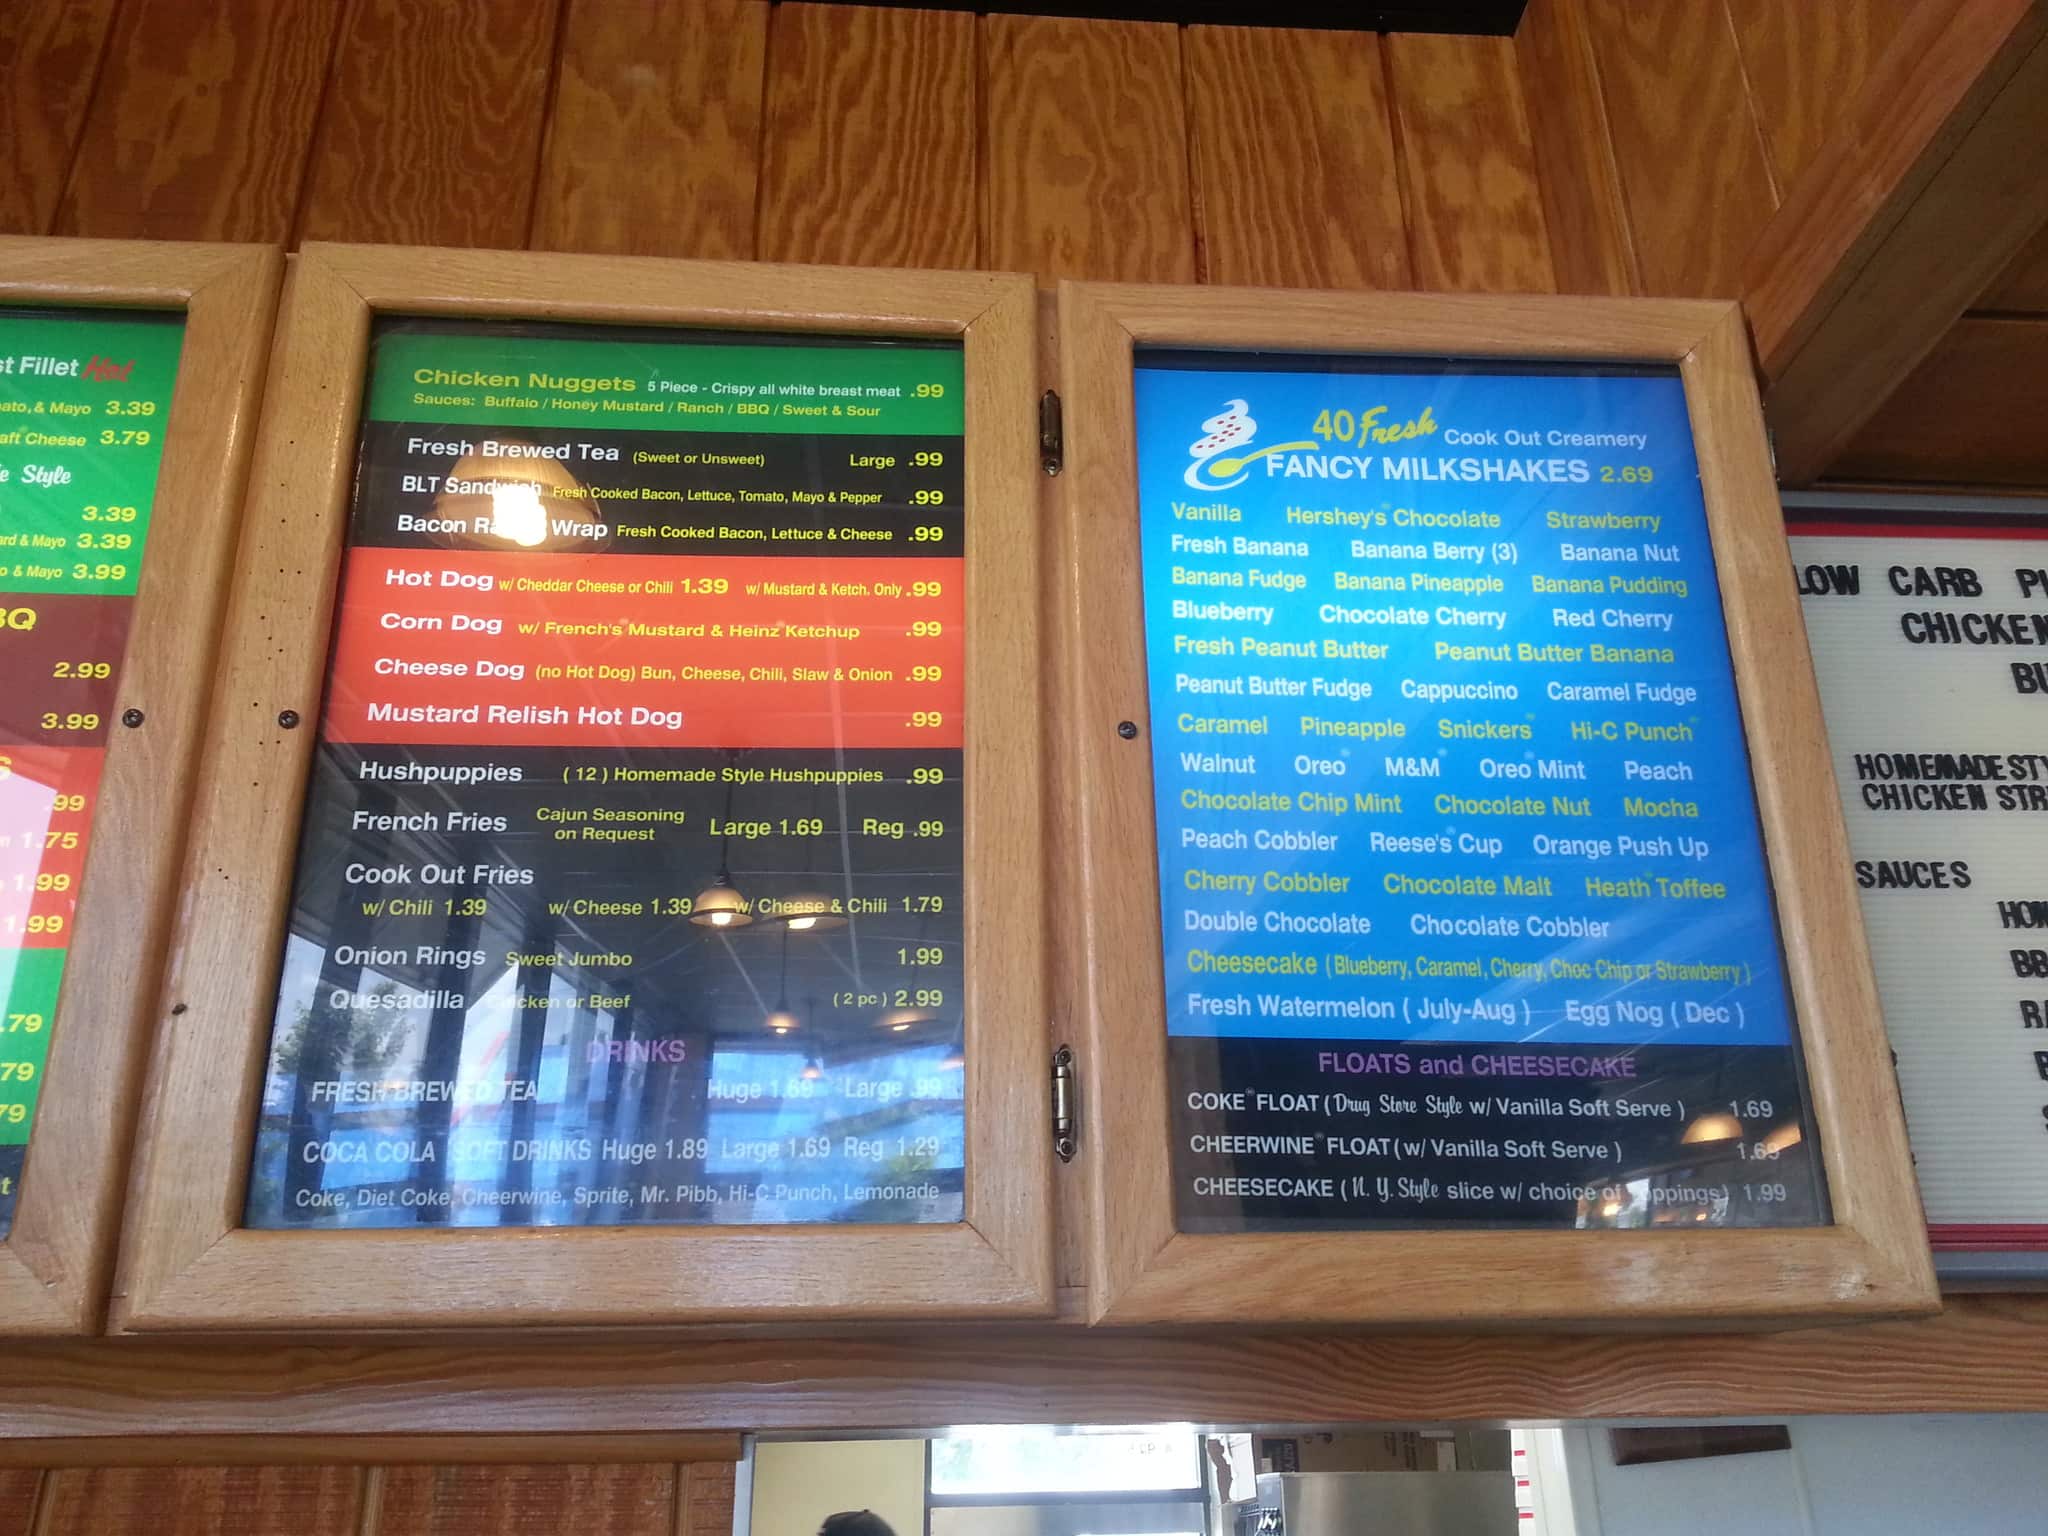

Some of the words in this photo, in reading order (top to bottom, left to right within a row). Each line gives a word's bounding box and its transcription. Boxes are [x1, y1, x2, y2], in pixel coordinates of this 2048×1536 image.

[19, 356, 79, 377] Fillet
[81, 355, 136, 382] Hot
[414, 368, 520, 387] Chicken
[528, 373, 637, 393] Nuggets
[660, 382, 698, 393] Piece
[711, 382, 756, 397] Crispy
[779, 384, 815, 396] white
[819, 385, 862, 397] breast
[910, 384, 944, 398] .99
[50, 402, 92, 417] Mayo
[105, 401, 156, 416] 3.39
[414, 393, 476, 407] Sauces:
[485, 396, 539, 409] Buffalo
[551, 398, 598, 412] Honey
[603, 400, 664, 413] Mustard
[677, 402, 724, 415] Ranch
[737, 403, 770, 416] BBQ
[847, 405, 881, 417] Sour
[25, 432, 87, 446] Cheese
[100, 430, 151, 446] 3.79
[1313, 409, 1355, 443] 40
[1358, 405, 1438, 449] Fresh
[1444, 429, 1498, 446] Cook
[1504, 430, 1541, 446] Out
[1546, 430, 1647, 450] Creamery
[407, 438, 474, 457] Fresh
[482, 440, 570, 460] Brewed
[577, 443, 620, 461] Tea
[849, 453, 896, 470] Large
[21, 464, 72, 488] Style
[1265, 453, 1372, 480] FANCY
[1383, 456, 1590, 483] MILKSHAKES
[1600, 466, 1654, 484] 2.69
[401, 475, 440, 492] BLT
[591, 487, 638, 500] Cooked
[792, 491, 825, 505] Mayo
[840, 492, 882, 505] Pepper
[1171, 501, 1242, 523] Vanilla
[1286, 506, 1387, 530] Hershey's
[1393, 509, 1501, 529] Chocolate
[1546, 511, 1662, 533] Strawberry
[32, 534, 67, 550] Mayo
[77, 533, 132, 549] 3.39
[551, 519, 608, 540] Wrap
[660, 526, 715, 540] Cooked
[840, 528, 893, 541] Cheese
[1171, 534, 1227, 554] Fresh
[1233, 536, 1309, 557] Banana
[1433, 541, 1485, 564] Berry
[1643, 544, 1681, 563] Nut
[27, 565, 63, 580] Mayo
[72, 563, 126, 580] 3.99
[385, 569, 432, 587] Hot
[440, 570, 493, 592] Dog
[517, 579, 571, 592] Cheddar
[576, 580, 625, 593] Cheese
[681, 578, 728, 594] 1.39
[1249, 569, 1307, 593] Fudge
[1411, 573, 1504, 595] Pineapple
[1610, 575, 1688, 597] Pudding
[1888, 565, 1983, 597] CARB
[380, 612, 442, 630] Corn
[451, 614, 503, 635] Dog
[544, 622, 623, 636] French's
[729, 625, 780, 638] Heinz
[785, 625, 860, 640] Ketchup
[1172, 599, 1274, 626] Blueberry
[1553, 608, 1595, 628] Red
[1602, 609, 1673, 632] Cherry
[1434, 641, 1511, 661] Peanut
[1517, 643, 1584, 662] Butter
[1590, 644, 1675, 664] Banana
[53, 661, 111, 680] 2.99
[374, 657, 468, 676] Cheese
[475, 660, 525, 681] Dog
[792, 667, 829, 681] Slaw
[849, 668, 893, 682] Onion
[1400, 679, 1519, 703] Cappuccino
[1546, 681, 1630, 702] Caramel
[1635, 683, 1697, 706] Fudge
[41, 712, 100, 730] 3.99
[367, 702, 479, 723] Mustard
[487, 705, 569, 725] Relish
[577, 707, 623, 726] Hot
[630, 707, 682, 730] Dog
[905, 711, 943, 728] .99
[1300, 716, 1406, 741] Pineapple
[1438, 719, 1533, 740] Snickers
[1624, 722, 1693, 742] Punch
[359, 761, 523, 785] Hushpuppies
[614, 767, 716, 782] Homemade
[721, 768, 765, 785] Style
[770, 768, 883, 785] Hushpuppies
[1181, 752, 1256, 774] Walnut
[1294, 755, 1346, 776] Oreo
[1385, 757, 1440, 777] M&M
[1624, 761, 1693, 781] Peach
[1853, 753, 2007, 781] HOMEMADE
[1354, 793, 1403, 814] Mint
[1624, 797, 1698, 818] Mocha
[1861, 783, 1988, 811] CHICKEN
[352, 811, 438, 832] French
[446, 812, 508, 832] Fries
[709, 818, 772, 840] Large
[779, 819, 823, 836] 1.69
[862, 818, 905, 839] Reg
[536, 807, 588, 823] Cajun
[592, 808, 685, 824] Seasoning
[582, 827, 655, 843] Request
[1254, 829, 1338, 851] Cobbler
[1370, 831, 1452, 853] Reese's
[1533, 834, 1611, 859] Orange
[1618, 835, 1672, 857] Push
[345, 863, 411, 884] Cook
[420, 864, 466, 885] Out
[473, 864, 535, 885] Fries
[1854, 860, 1972, 889] SAUCES
[1504, 875, 1552, 897] Malt
[1656, 877, 1726, 899] Toffee
[388, 899, 433, 916] Chili
[902, 896, 943, 913] 1.79
[1184, 909, 1257, 932] Double
[1264, 911, 1371, 934] Chocolate
[334, 946, 409, 966] Onion
[416, 947, 487, 970] Rings
[569, 952, 633, 967] Jumbo
[898, 948, 943, 965] 1.99
[1187, 949, 1317, 975] Cheesecake
[329, 989, 464, 1010] Quesadilla
[894, 989, 943, 1008] 2.99
[1257, 994, 1395, 1019] Watermelon
[1566, 1000, 1610, 1026] Egg
[1616, 1001, 1664, 1026] Nog
[1318, 1052, 1411, 1074] FLOATS
[1419, 1055, 1464, 1075] and
[1471, 1055, 1637, 1077] CHEESECAKE
[1188, 1092, 1245, 1110] COKE
[1256, 1093, 1319, 1112] FLOAT
[1615, 1100, 1672, 1117] Serve
[1730, 1100, 1773, 1118] 1.69
[602, 1139, 657, 1165] Huge
[664, 1139, 708, 1159] 1.89
[1190, 1135, 1315, 1155] CHEERWINE
[1431, 1139, 1499, 1157] Vanilla
[357, 1188, 395, 1207] Diet
[844, 1182, 940, 1201] Lemonade
[1193, 1177, 1334, 1197] CHEESECAKE
[1447, 1182, 1493, 1199] slice
[1744, 1184, 1787, 1202] 1.99
